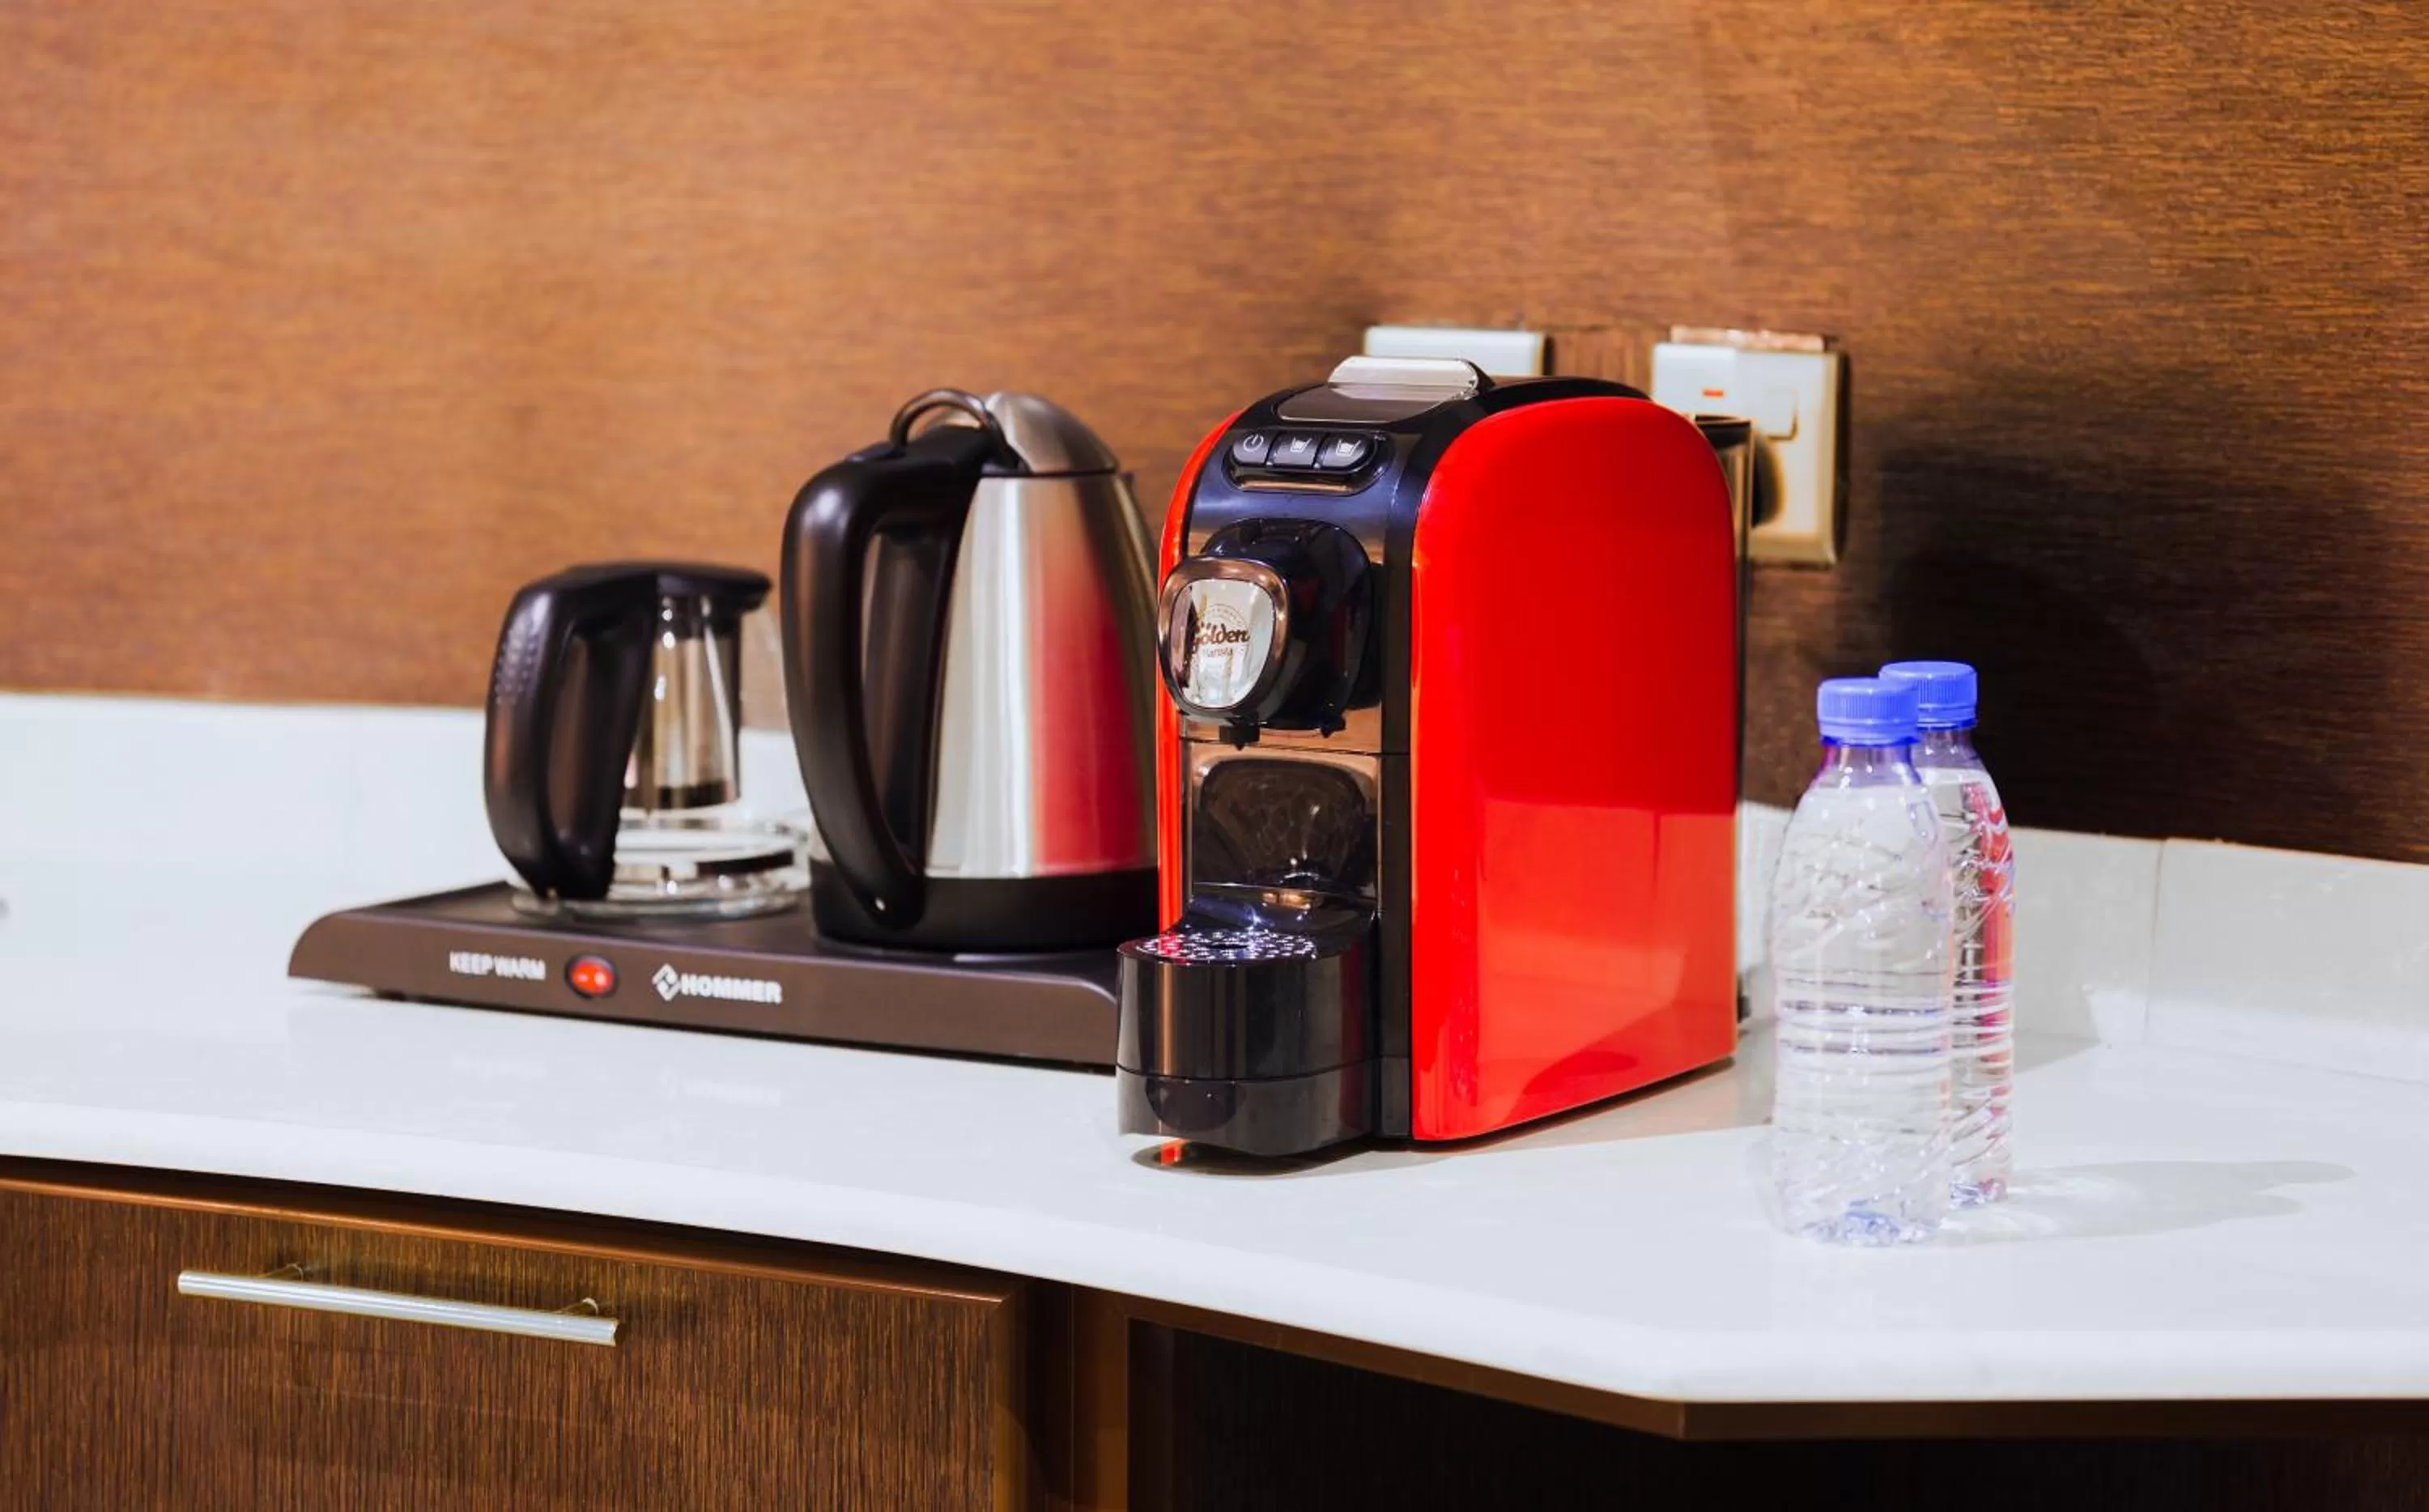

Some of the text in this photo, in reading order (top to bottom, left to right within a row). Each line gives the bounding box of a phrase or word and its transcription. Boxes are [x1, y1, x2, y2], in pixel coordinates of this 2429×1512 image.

[449, 950, 546, 981] KEEP WARM
[680, 973, 782, 1004] HOMMER
